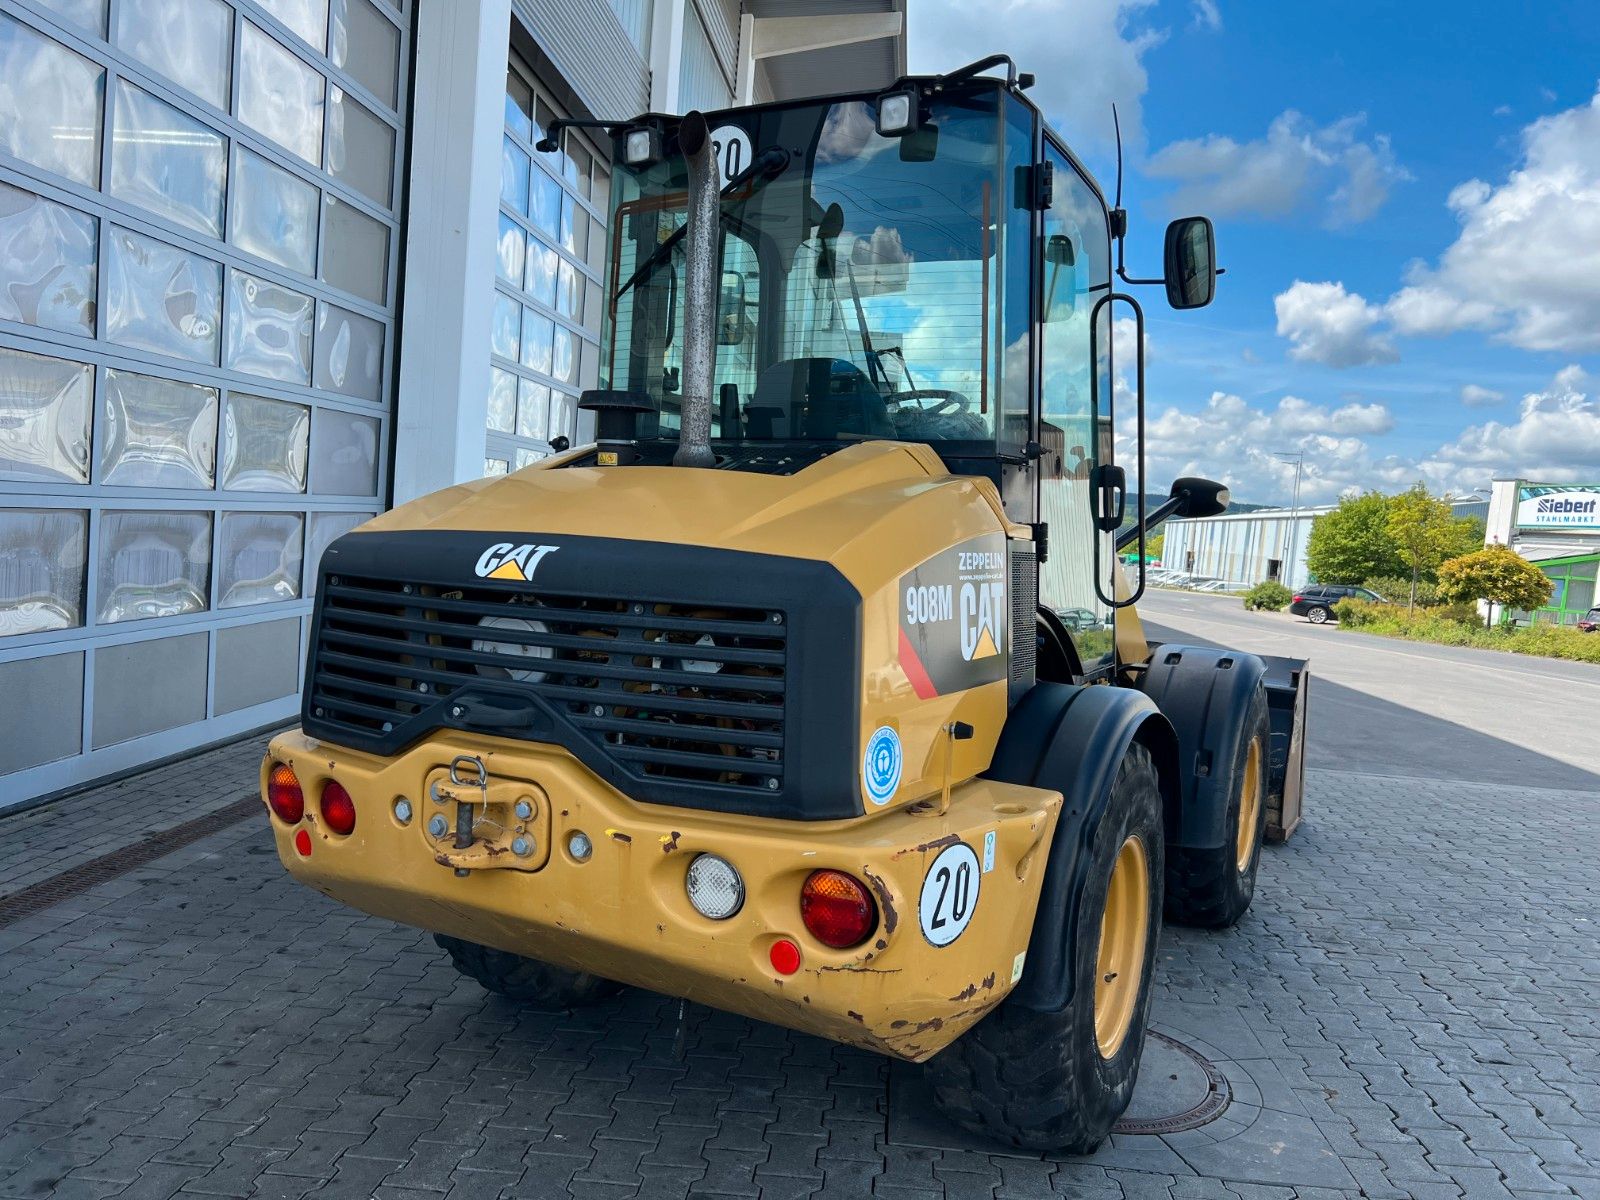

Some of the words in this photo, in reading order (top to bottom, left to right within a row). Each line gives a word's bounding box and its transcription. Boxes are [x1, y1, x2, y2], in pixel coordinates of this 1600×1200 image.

[1536, 515, 1595, 523] STAHLMARKT
[1537, 498, 1596, 513] Siebert
[474, 542, 561, 581] CAT
[958, 552, 1004, 571] ZEPPELIN
[906, 584, 953, 625] 908M
[960, 581, 1004, 661] CAT
[930, 861, 971, 931] 20
